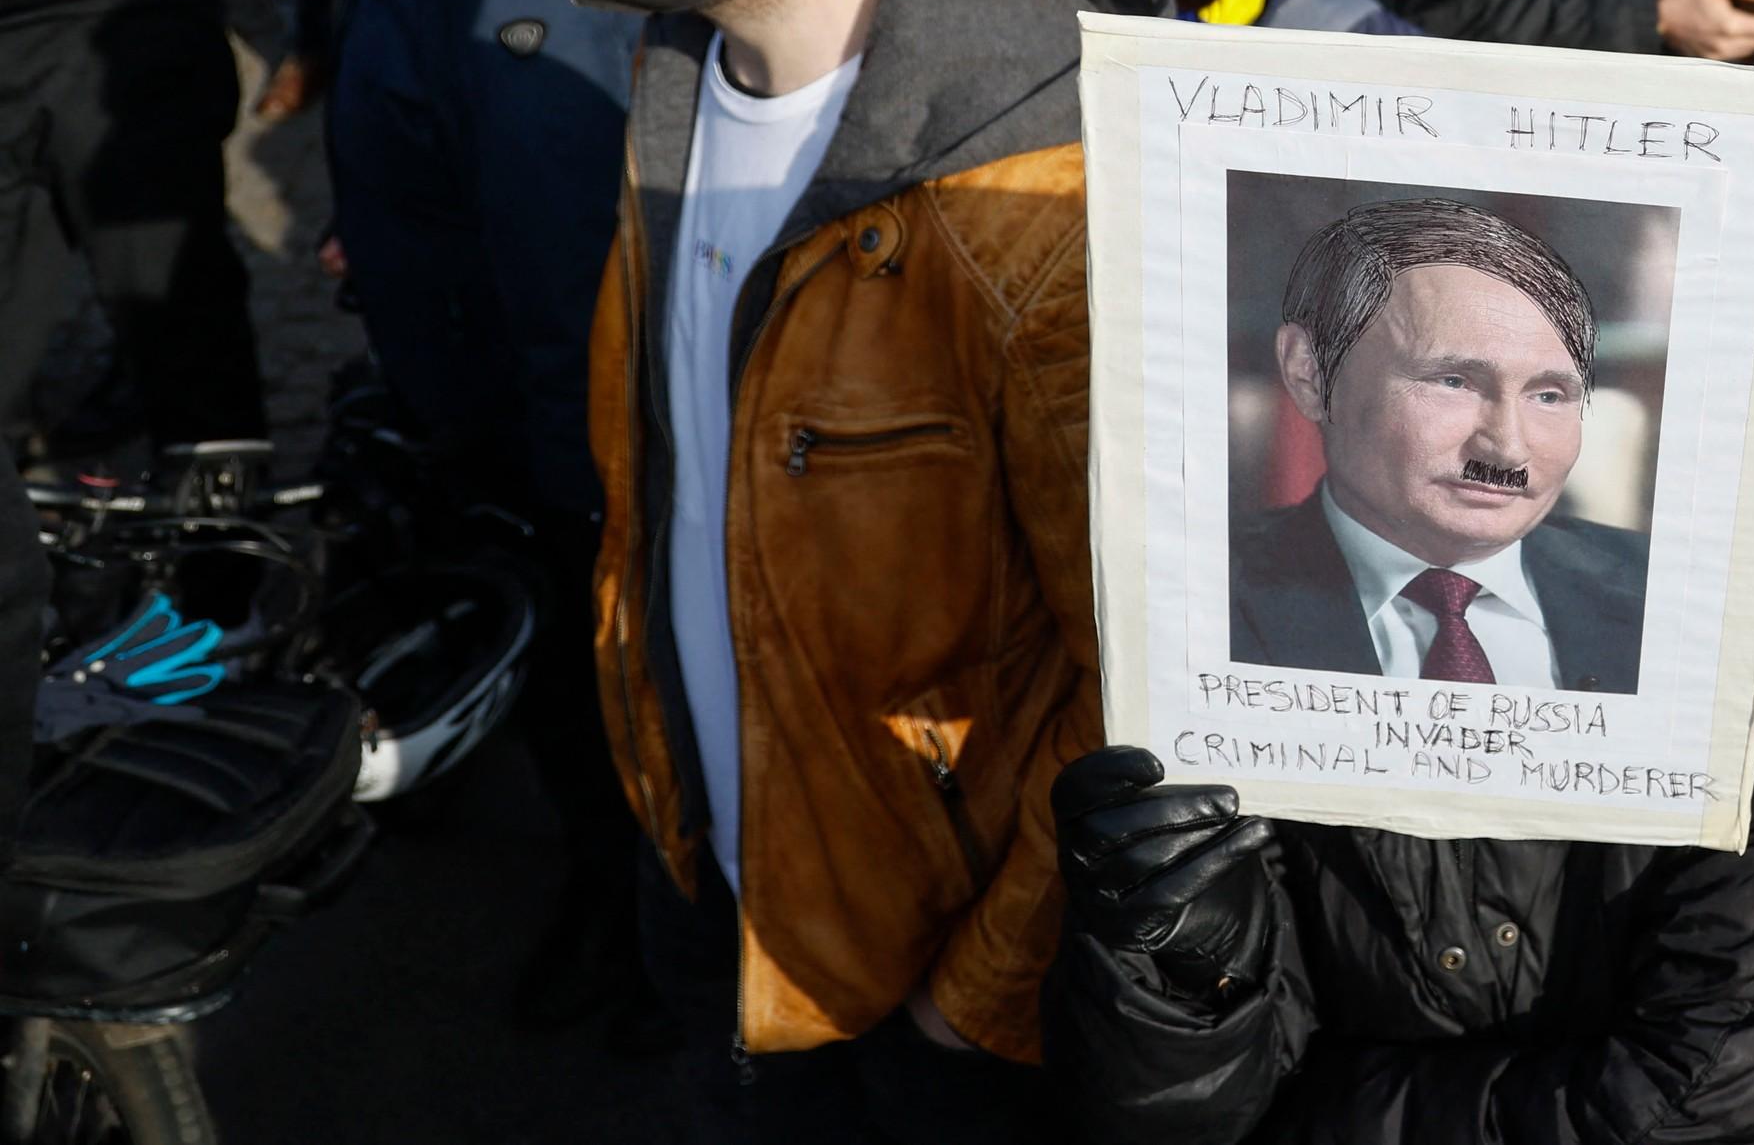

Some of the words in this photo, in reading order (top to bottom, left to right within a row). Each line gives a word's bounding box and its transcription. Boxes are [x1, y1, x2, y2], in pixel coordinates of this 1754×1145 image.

[1168, 75, 1440, 138] VLADIMIR
[1506, 105, 1721, 163] HITLER
[1198, 673, 1409, 717] PRESIDENT
[1428, 689, 1473, 721] OF
[1489, 693, 1607, 737] RUSSIA
[1174, 730, 1389, 775] CRIMINAL
[1411, 751, 1492, 784] AND
[1519, 759, 1720, 801] MURDERER
[1373, 721, 1534, 759] INVADER
